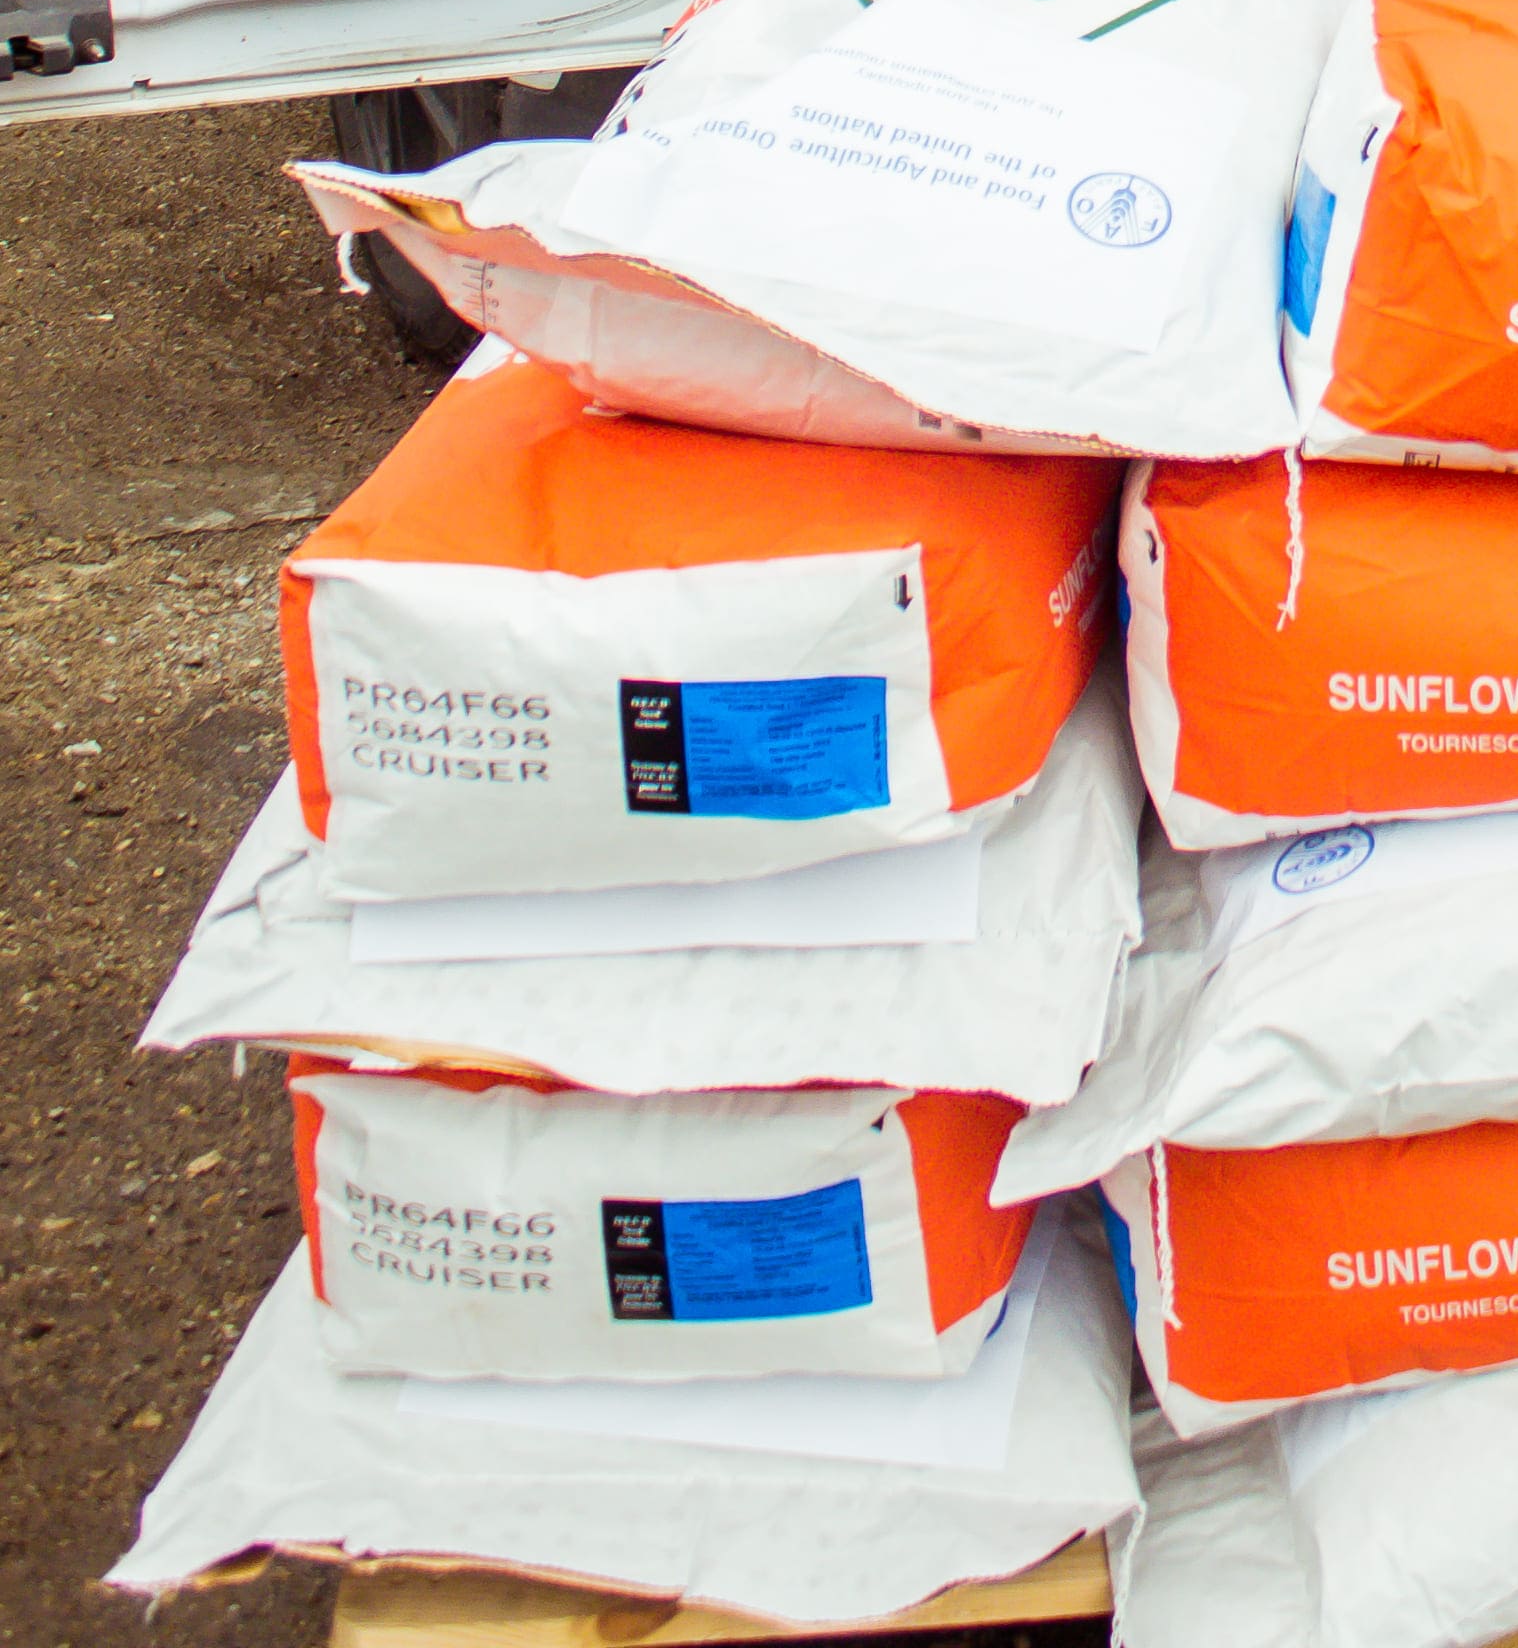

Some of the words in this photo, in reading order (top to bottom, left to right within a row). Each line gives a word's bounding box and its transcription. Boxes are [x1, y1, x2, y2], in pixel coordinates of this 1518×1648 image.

[790, 104, 883, 141] Nations
[789, 137, 928, 182] Agriculture
[890, 125, 973, 162] United
[983, 150, 1023, 175] the
[931, 167, 979, 196] and
[1026, 159, 1057, 182] of
[982, 180, 1047, 212] Food
[343, 677, 551, 723] PR64F66
[347, 713, 551, 752] 5684398
[351, 743, 550, 784] CRUISER
[343, 1181, 555, 1239] PR64F66
[350, 1241, 551, 1293] CRUISER
